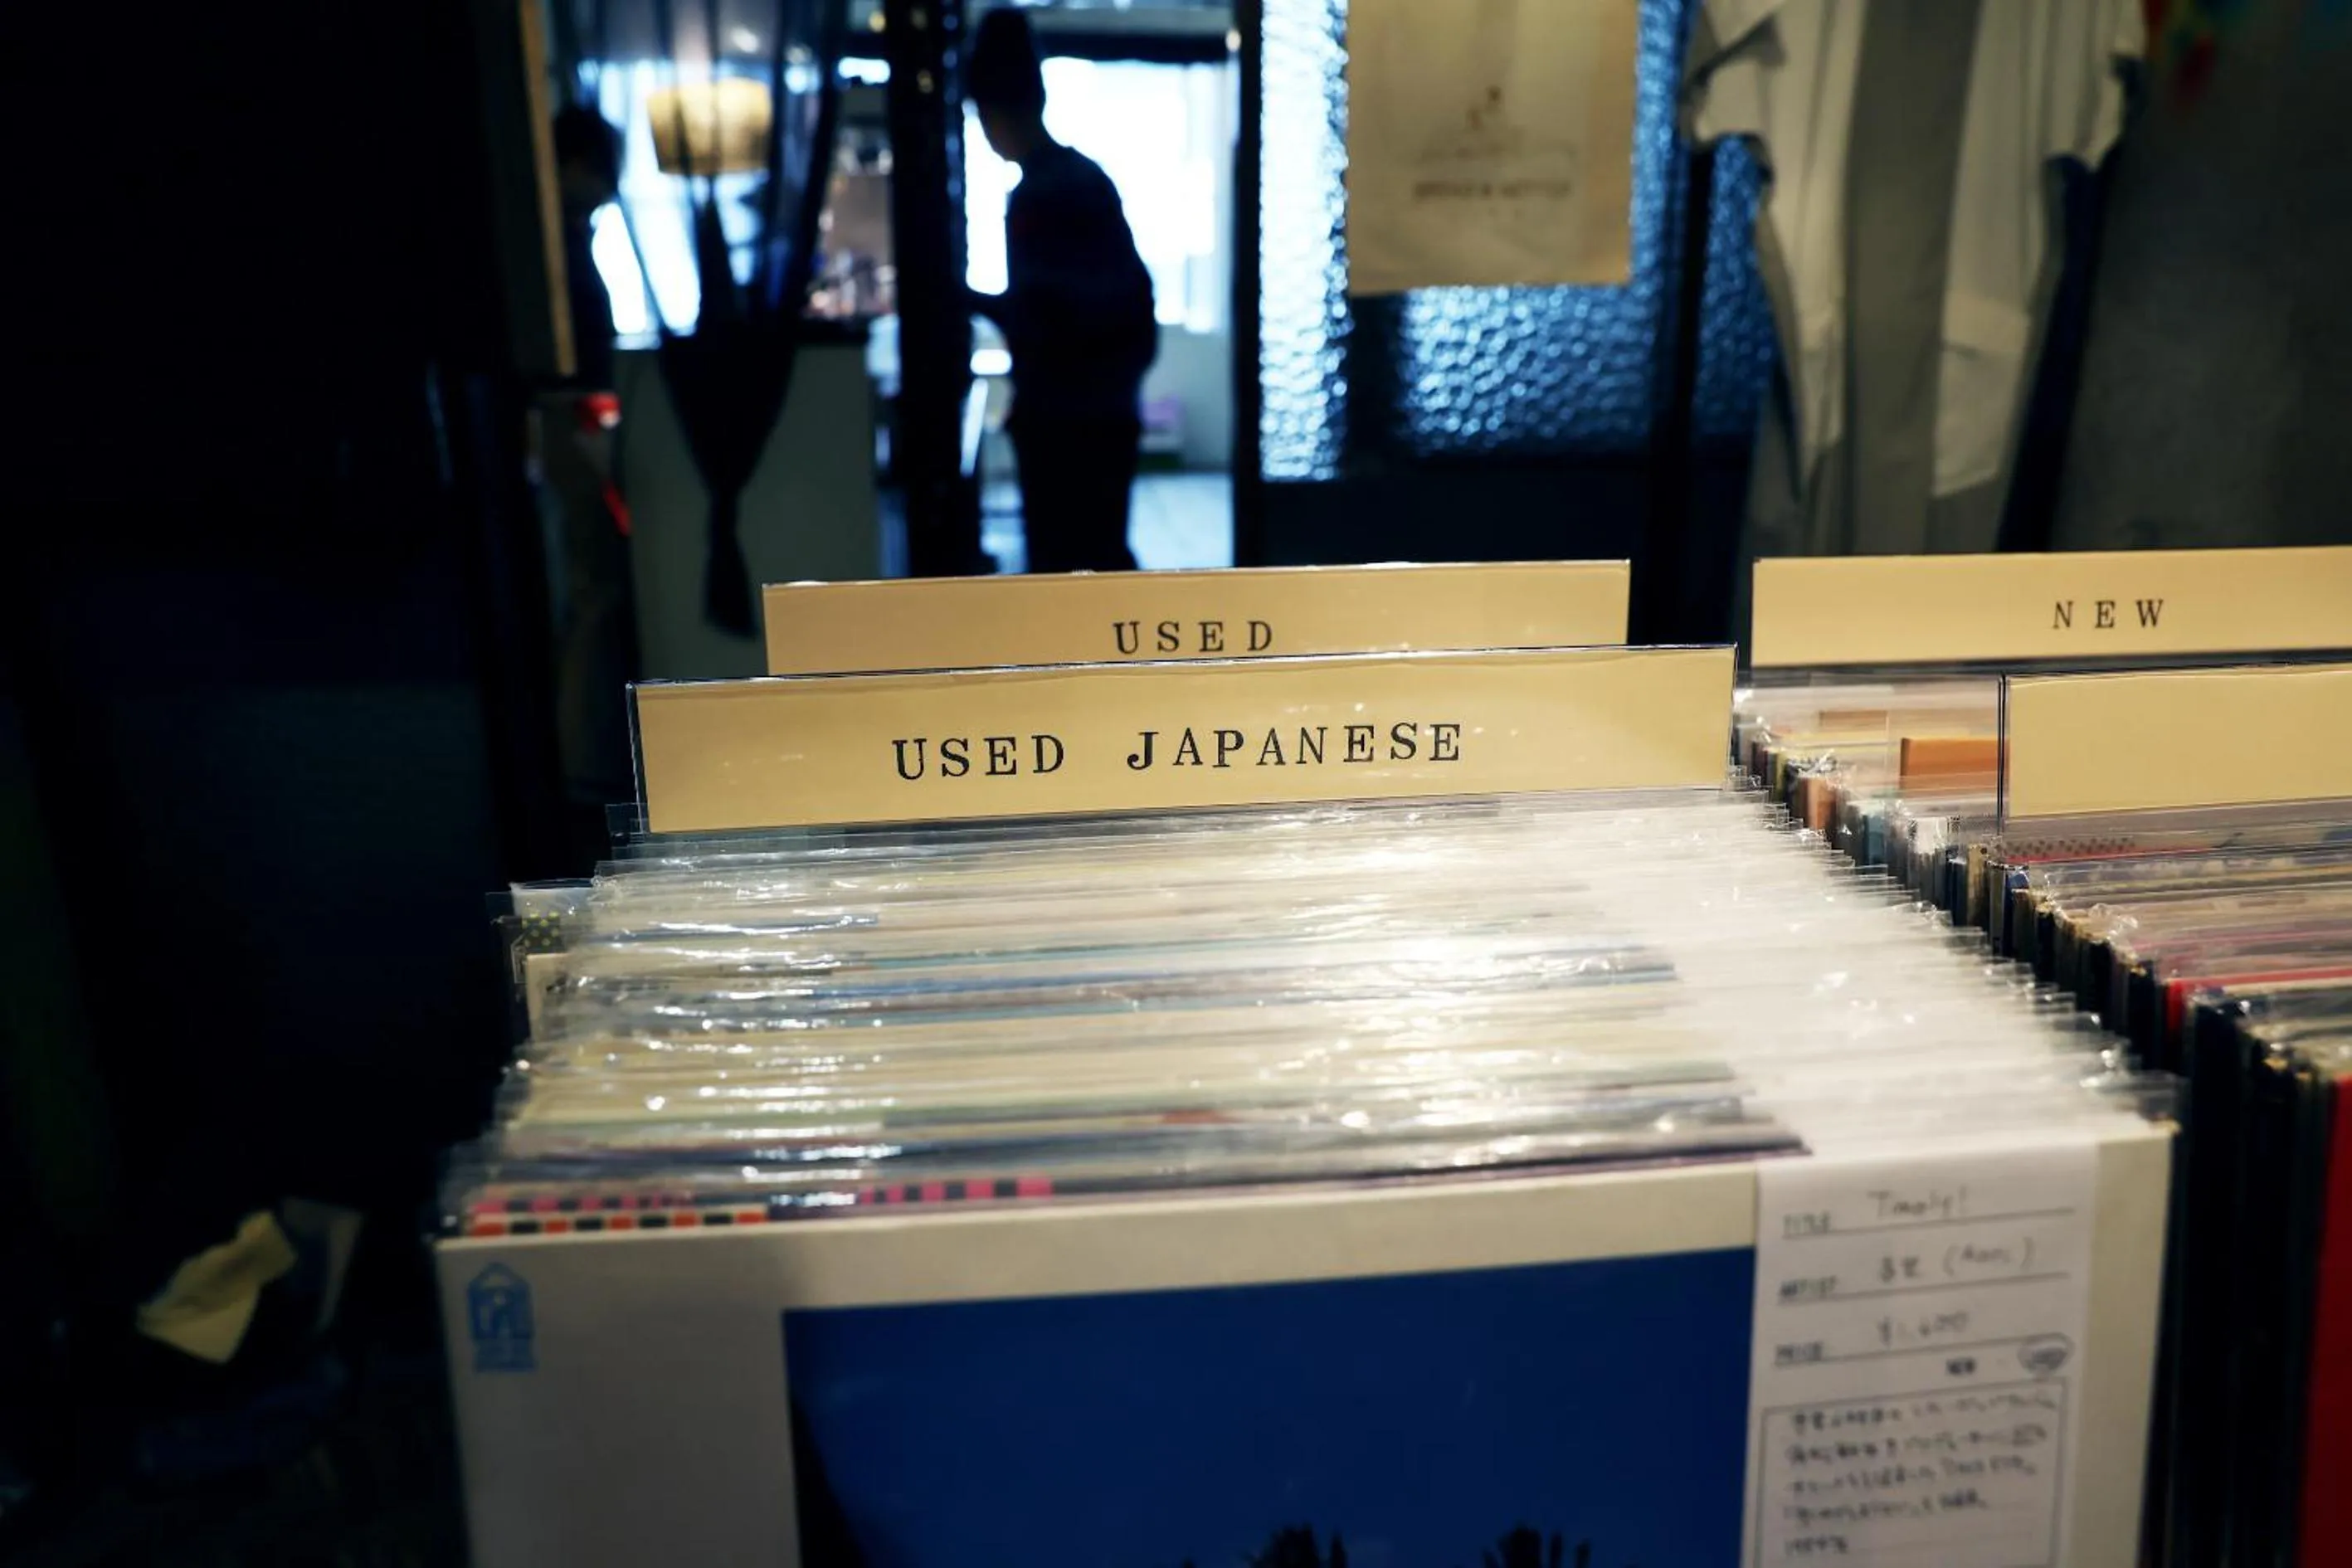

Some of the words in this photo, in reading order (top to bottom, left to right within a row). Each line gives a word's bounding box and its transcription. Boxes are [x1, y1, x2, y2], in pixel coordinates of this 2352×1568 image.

[2053, 599, 2164, 630] NEW
[1112, 621, 1273, 655] USED
[892, 734, 1065, 781] USED
[1126, 722, 1461, 772] JAPANESE
